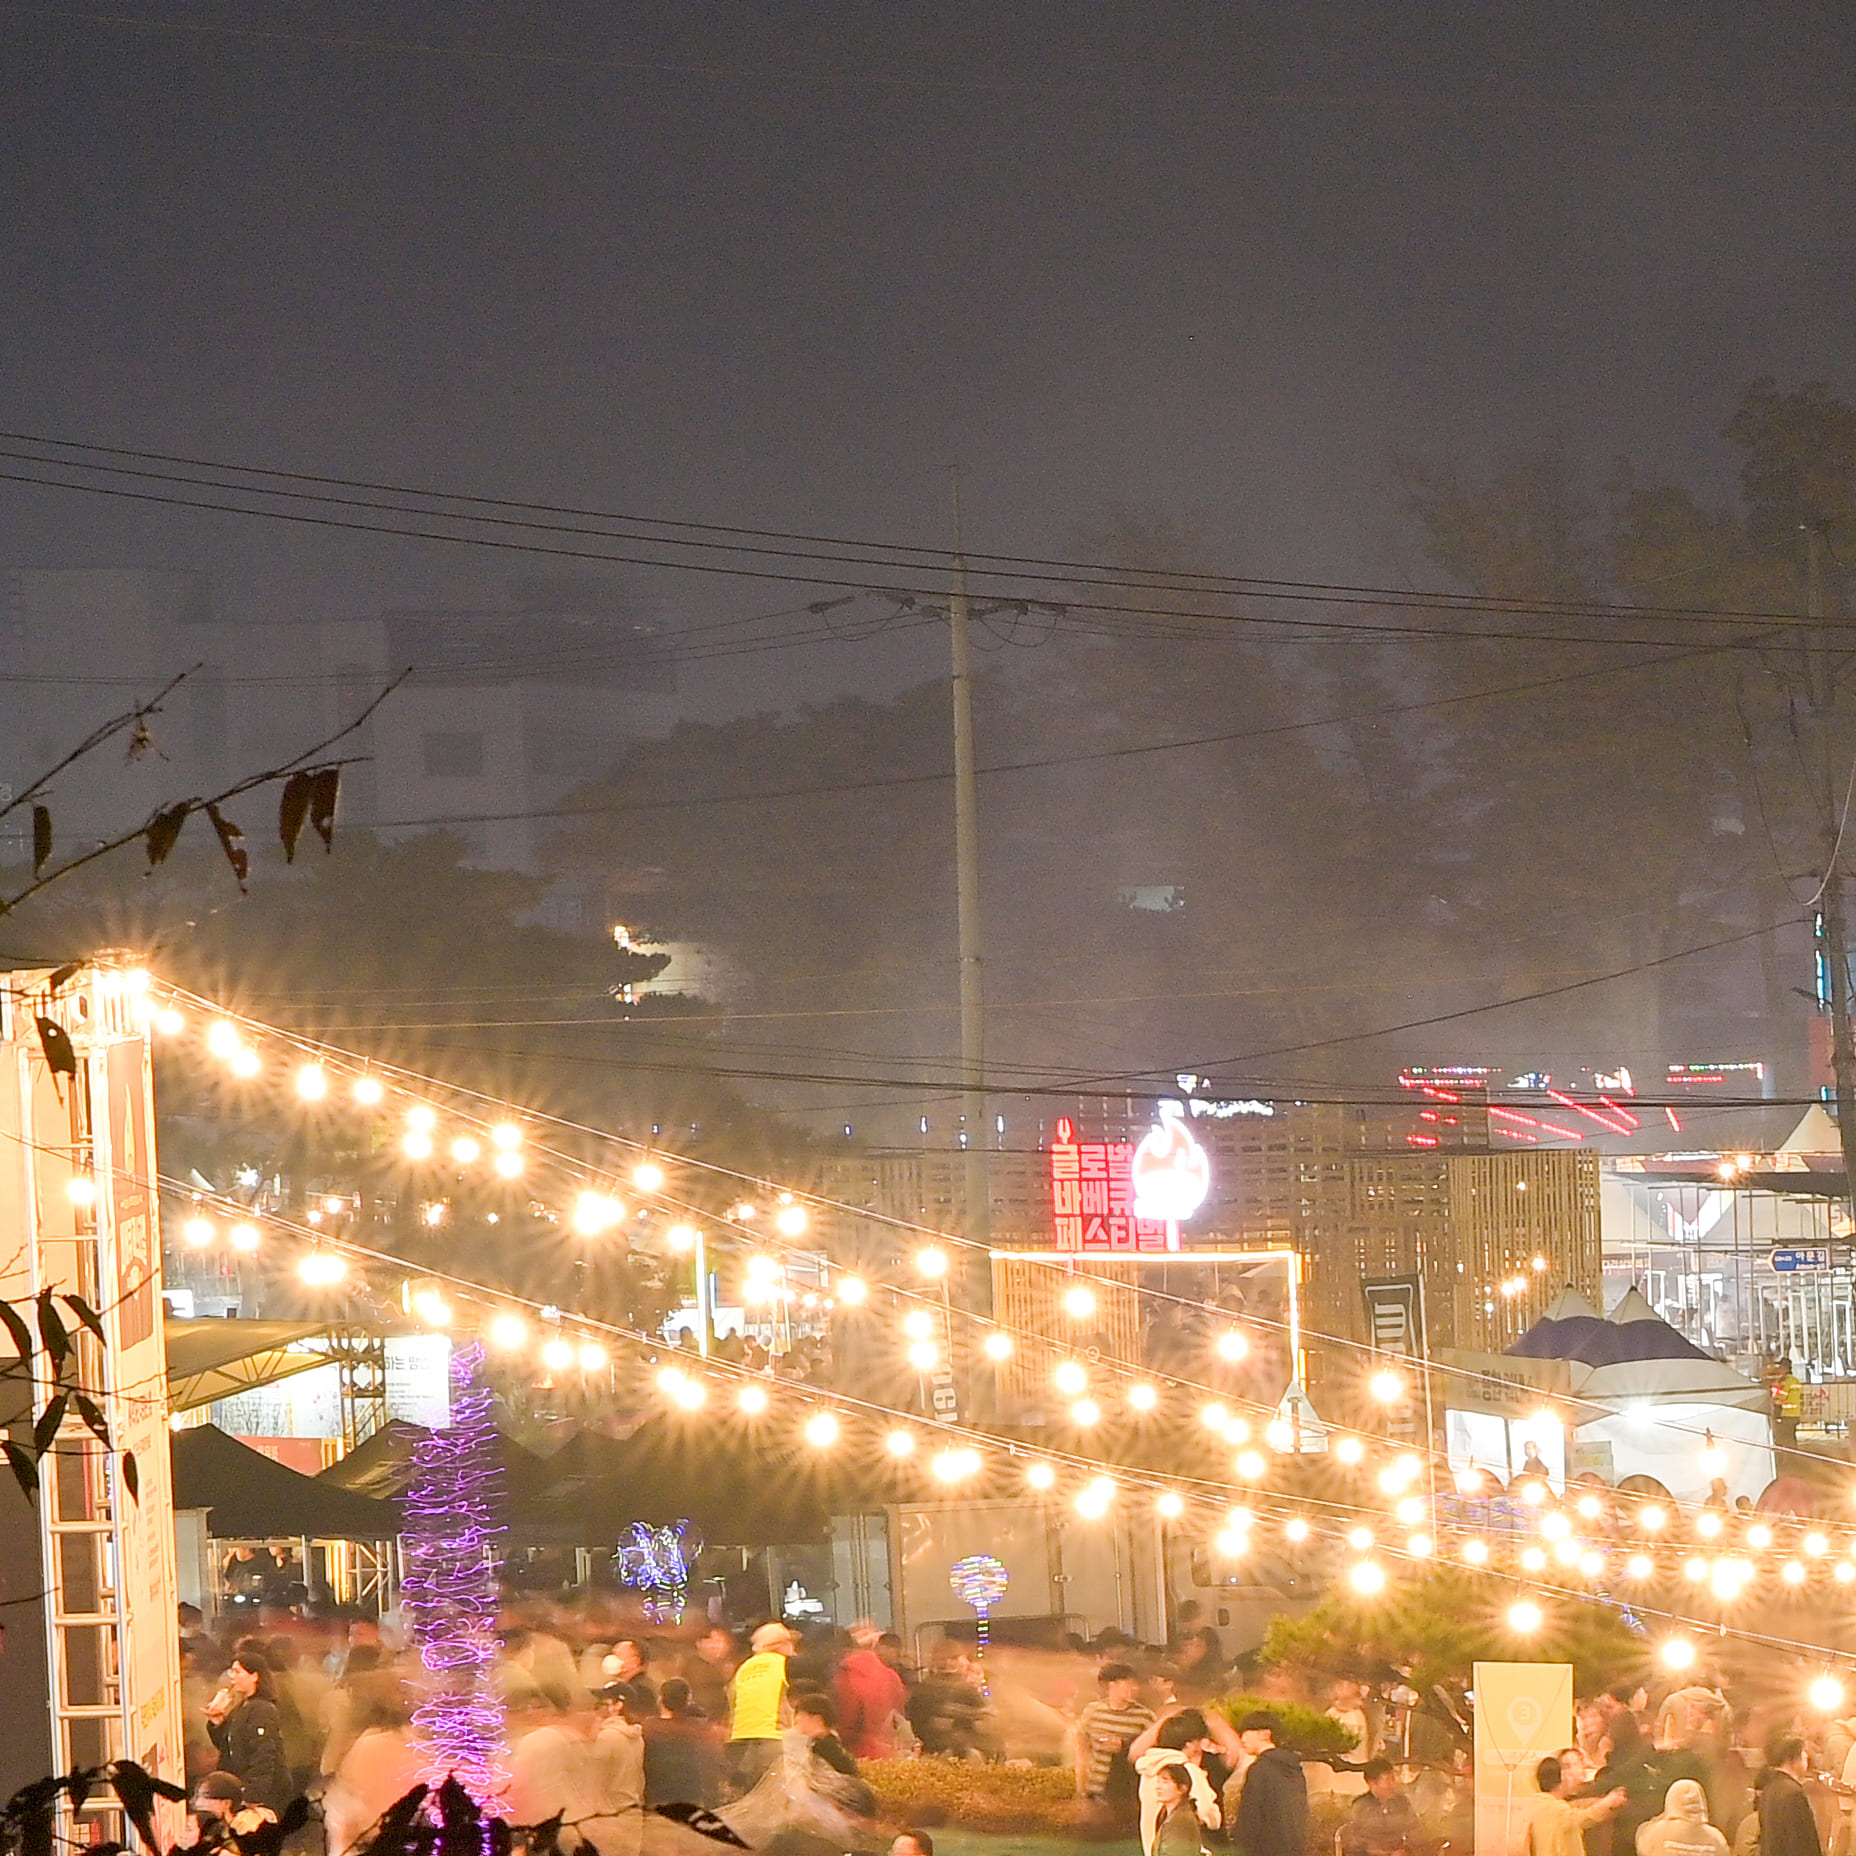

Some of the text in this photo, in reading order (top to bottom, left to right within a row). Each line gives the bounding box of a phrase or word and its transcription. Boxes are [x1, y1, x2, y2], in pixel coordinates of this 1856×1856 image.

[1052, 1143, 1137, 1180] 글로벌
[1053, 1181, 1137, 1216] 바베큐
[1055, 1216, 1168, 1251] 페스티벌
